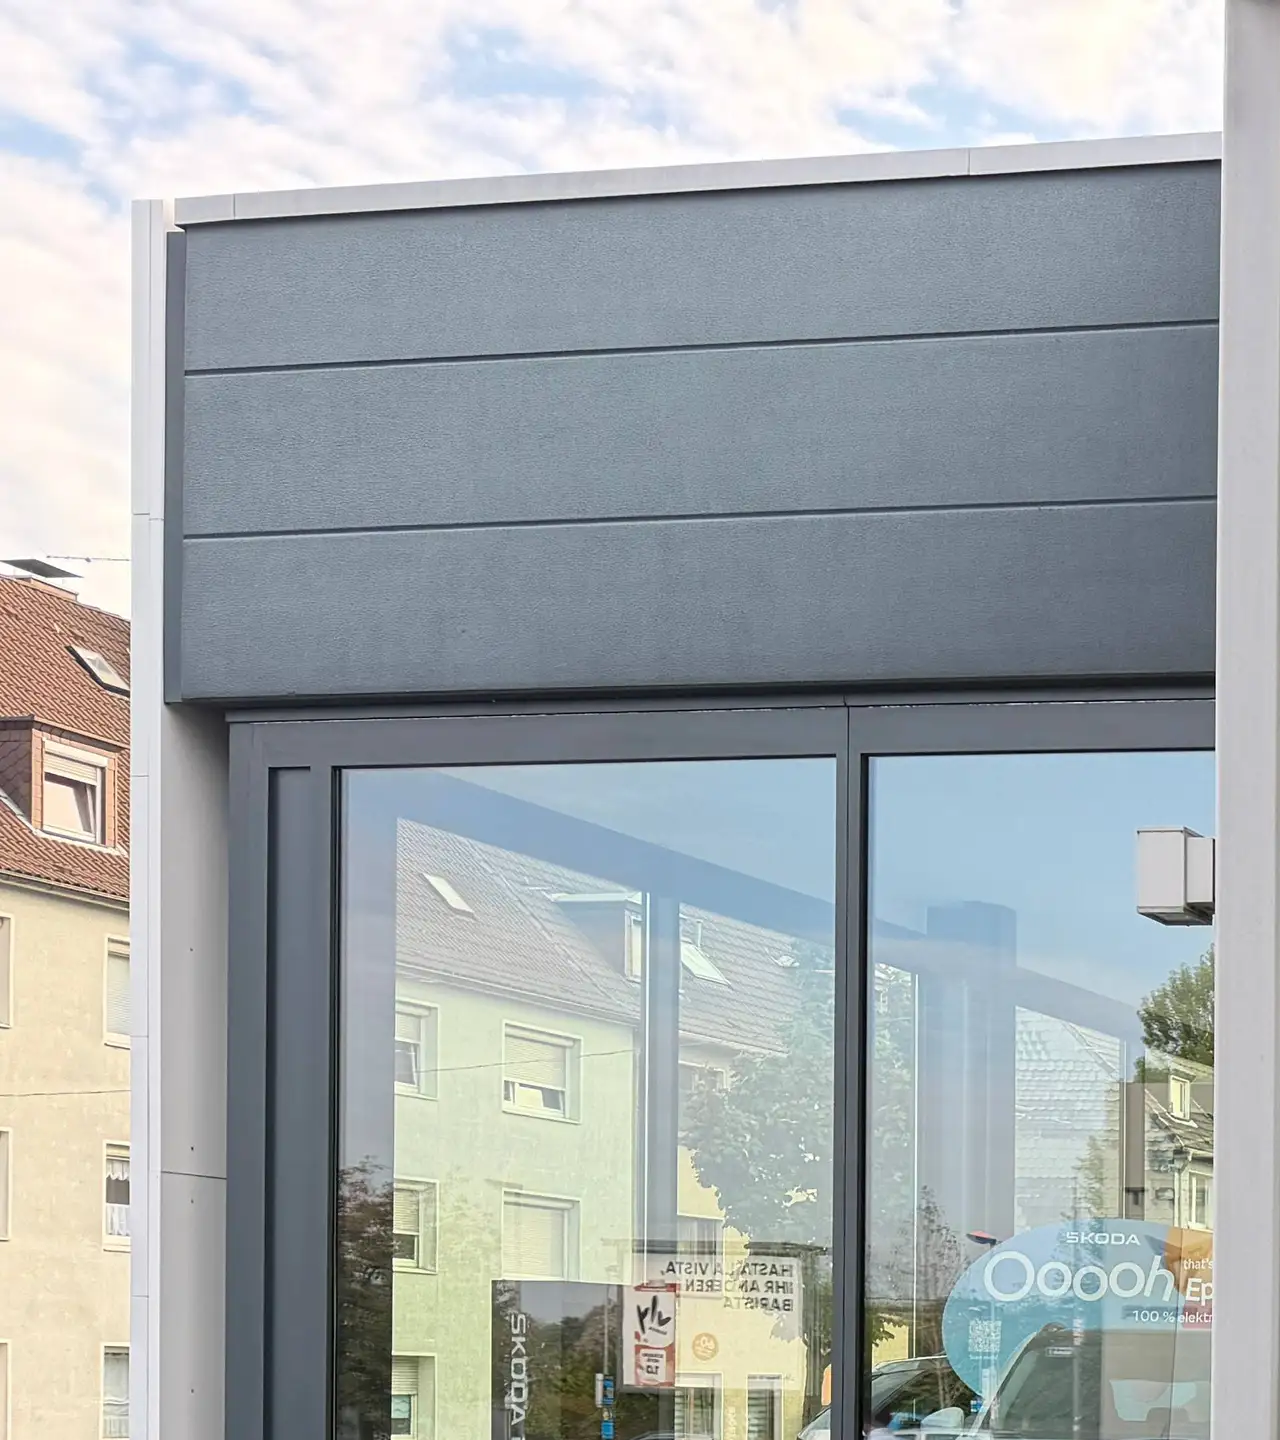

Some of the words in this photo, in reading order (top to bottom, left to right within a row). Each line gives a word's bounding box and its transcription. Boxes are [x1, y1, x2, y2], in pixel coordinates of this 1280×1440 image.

[983, 1249, 1176, 1303] Ooooh
[1132, 1310, 1159, 1323] 100
[1162, 1311, 1176, 1323] %
